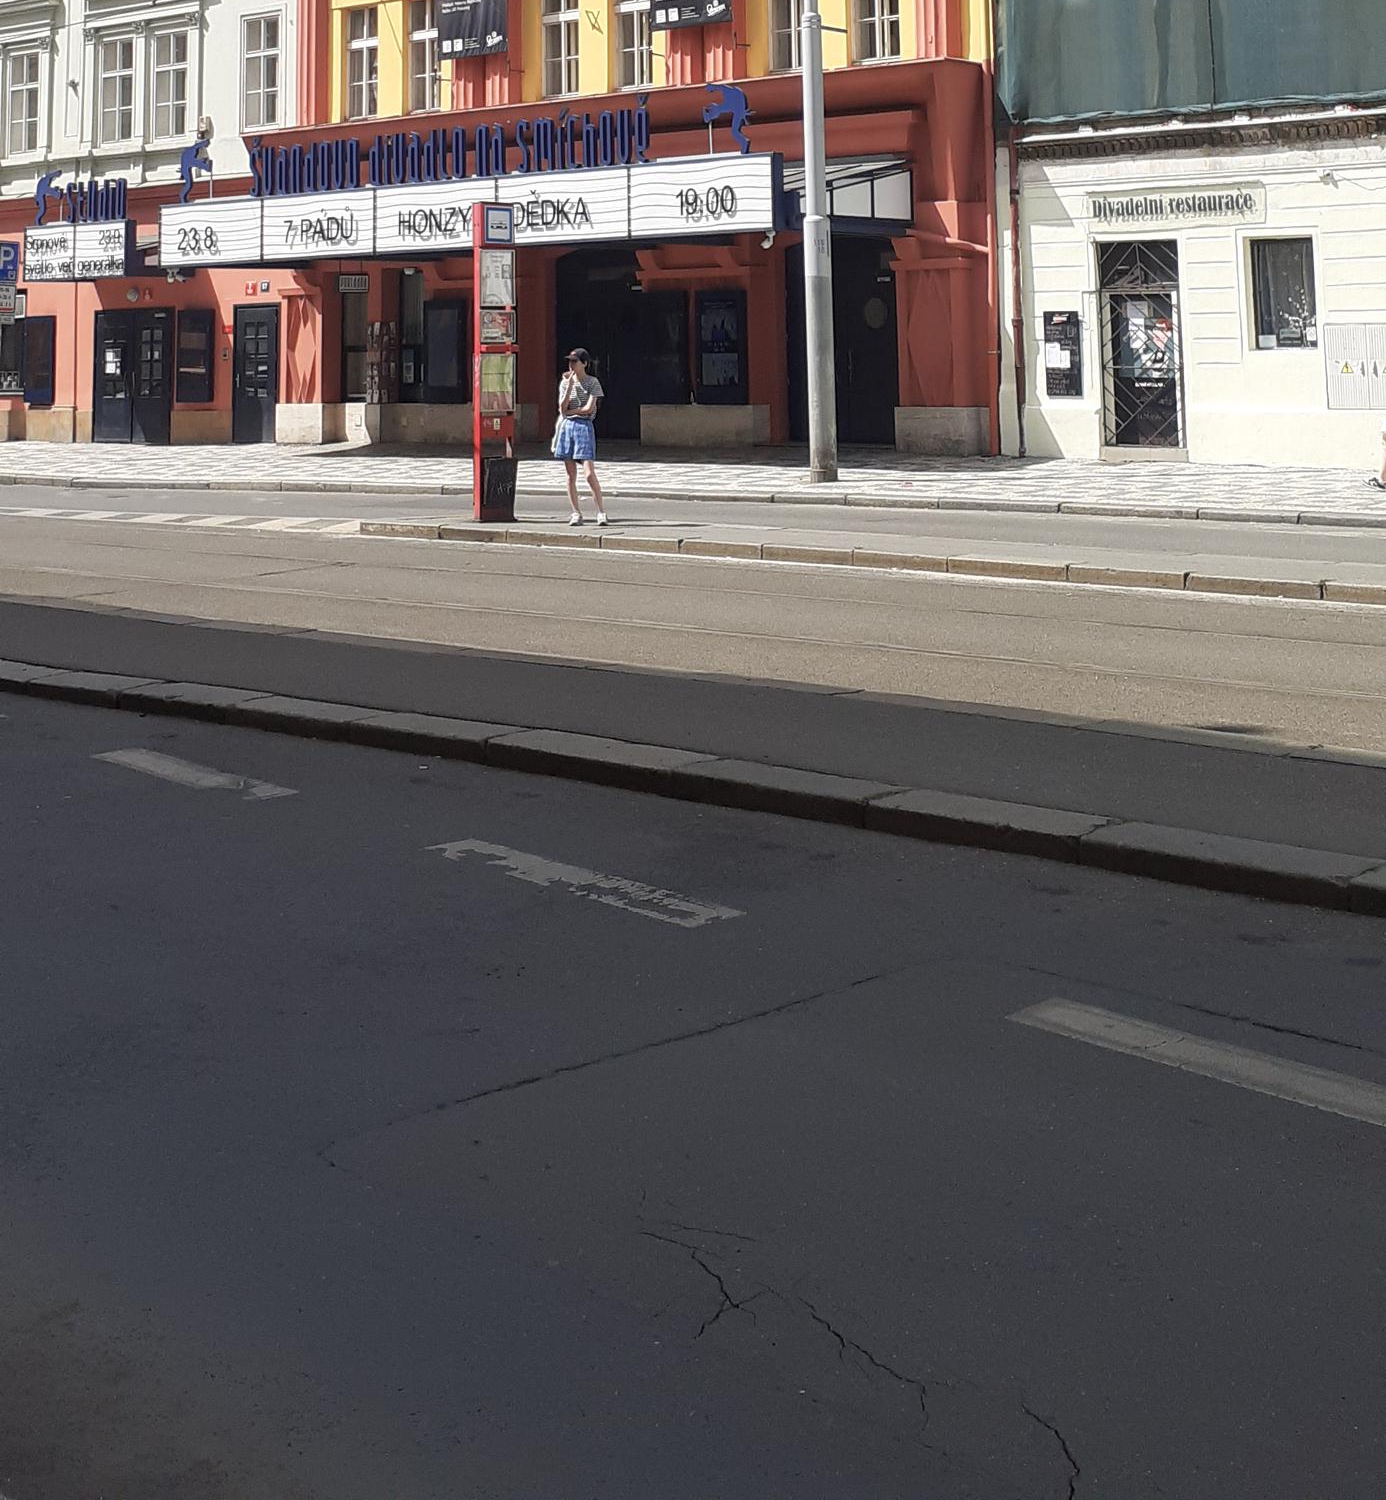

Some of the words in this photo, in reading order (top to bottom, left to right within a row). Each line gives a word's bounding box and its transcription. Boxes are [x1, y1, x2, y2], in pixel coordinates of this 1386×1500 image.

[249, 136, 360, 198] Švandovo
[368, 125, 465, 187] divadlo
[475, 121, 506, 177] na
[515, 93, 650, 174] Smíchově
[177, 225, 217, 251] 23.8.
[283, 220, 294, 244] 7
[300, 206, 354, 243] PÁDŮ
[398, 205, 472, 236] HONZY
[512, 189, 590, 228] DĚDKA
[1092, 194, 1164, 219] Divadelní
[1168, 187, 1254, 215] restaurace
